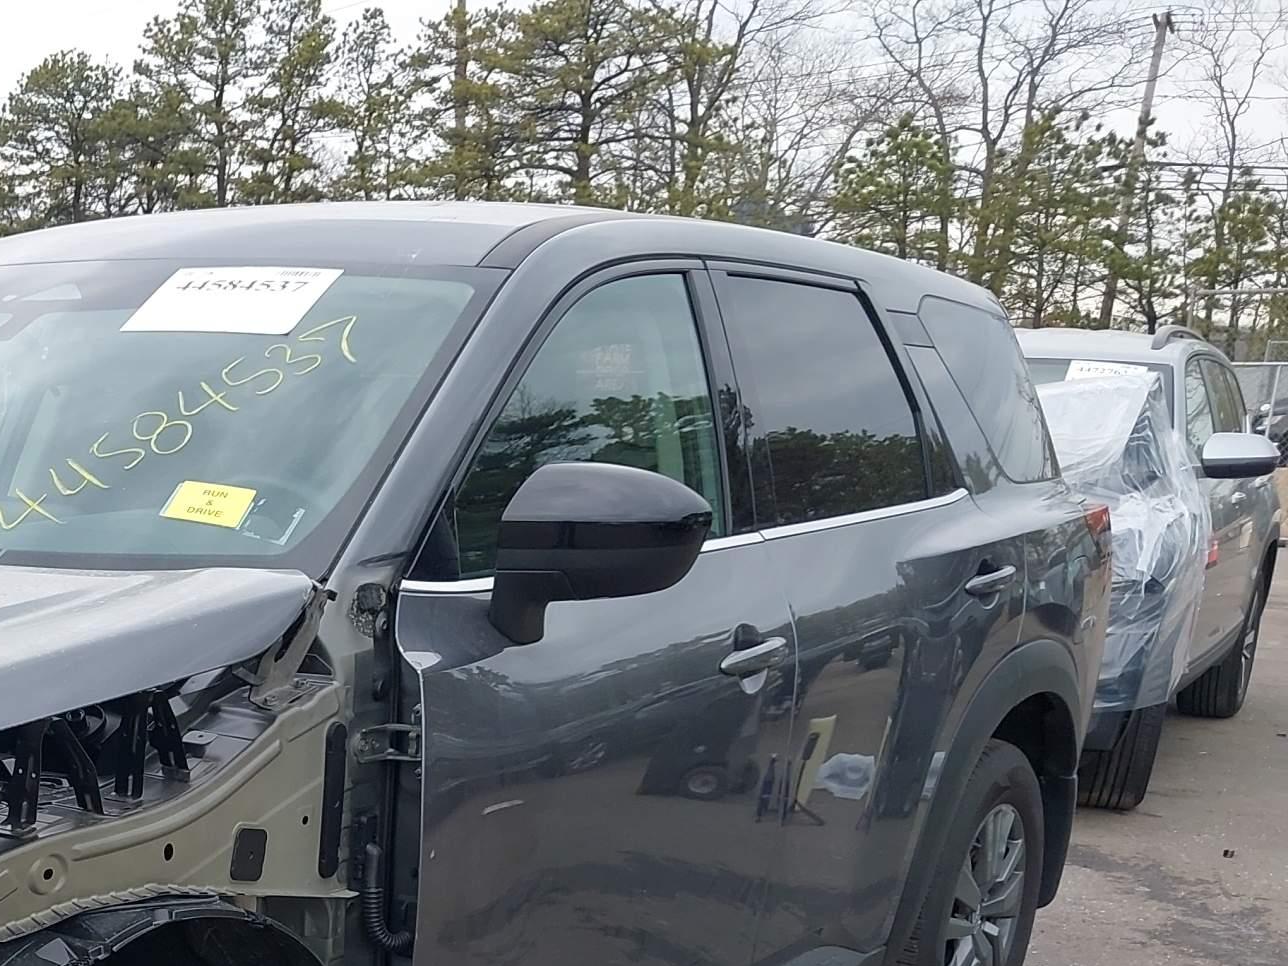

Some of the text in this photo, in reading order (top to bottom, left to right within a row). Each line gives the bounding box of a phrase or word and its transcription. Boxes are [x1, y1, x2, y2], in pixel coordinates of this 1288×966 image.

[176, 279, 309, 292] 44584537
[203, 489, 228, 499] RUN
[186, 506, 224, 518] DRIVE
